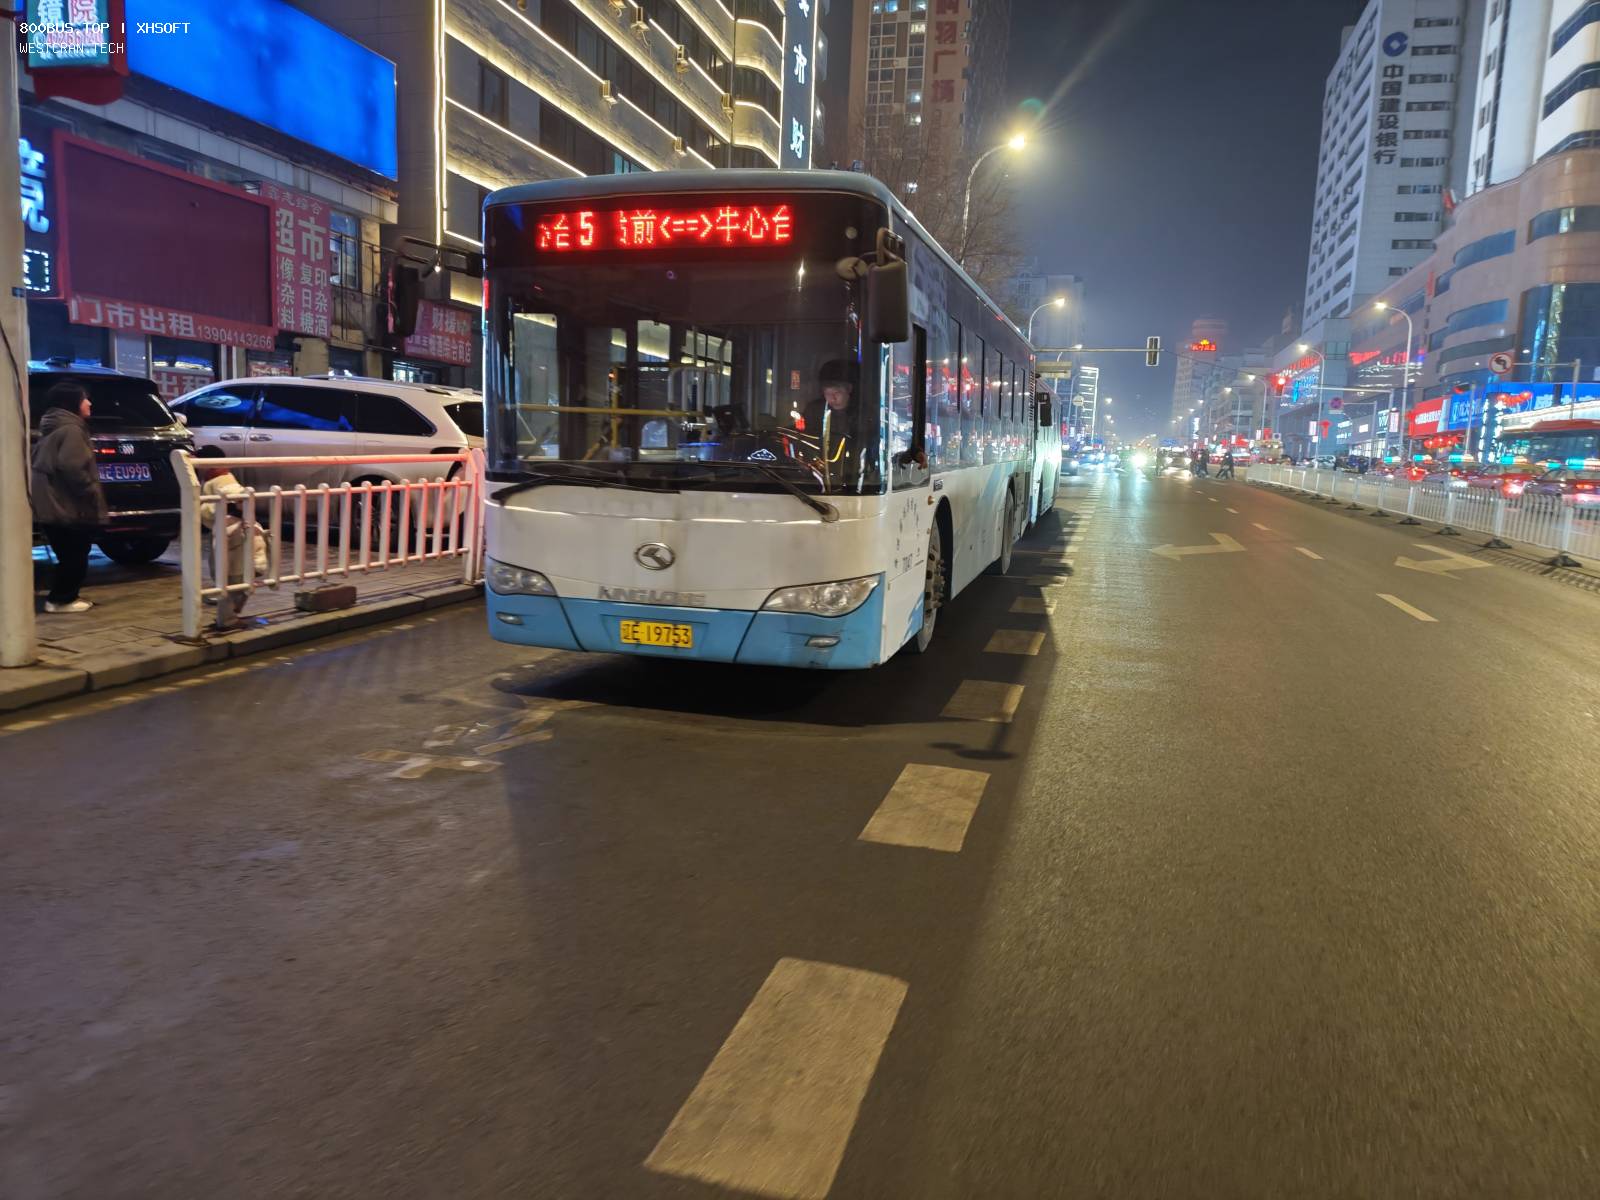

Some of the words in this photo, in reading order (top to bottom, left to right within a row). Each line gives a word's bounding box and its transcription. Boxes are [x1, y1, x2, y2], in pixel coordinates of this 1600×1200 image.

[1373, 64, 1404, 165] 中国建设银行
[276, 207, 327, 262] 超市
[276, 256, 295, 282] 像
[300, 263, 328, 290] 复印
[276, 283, 295, 306] 杂
[301, 289, 328, 314] 日杂
[72, 295, 196, 338] 门市出租
[197, 325, 273, 349] 13904143266
[277, 307, 295, 332] 料
[300, 311, 328, 338] 糖酒
